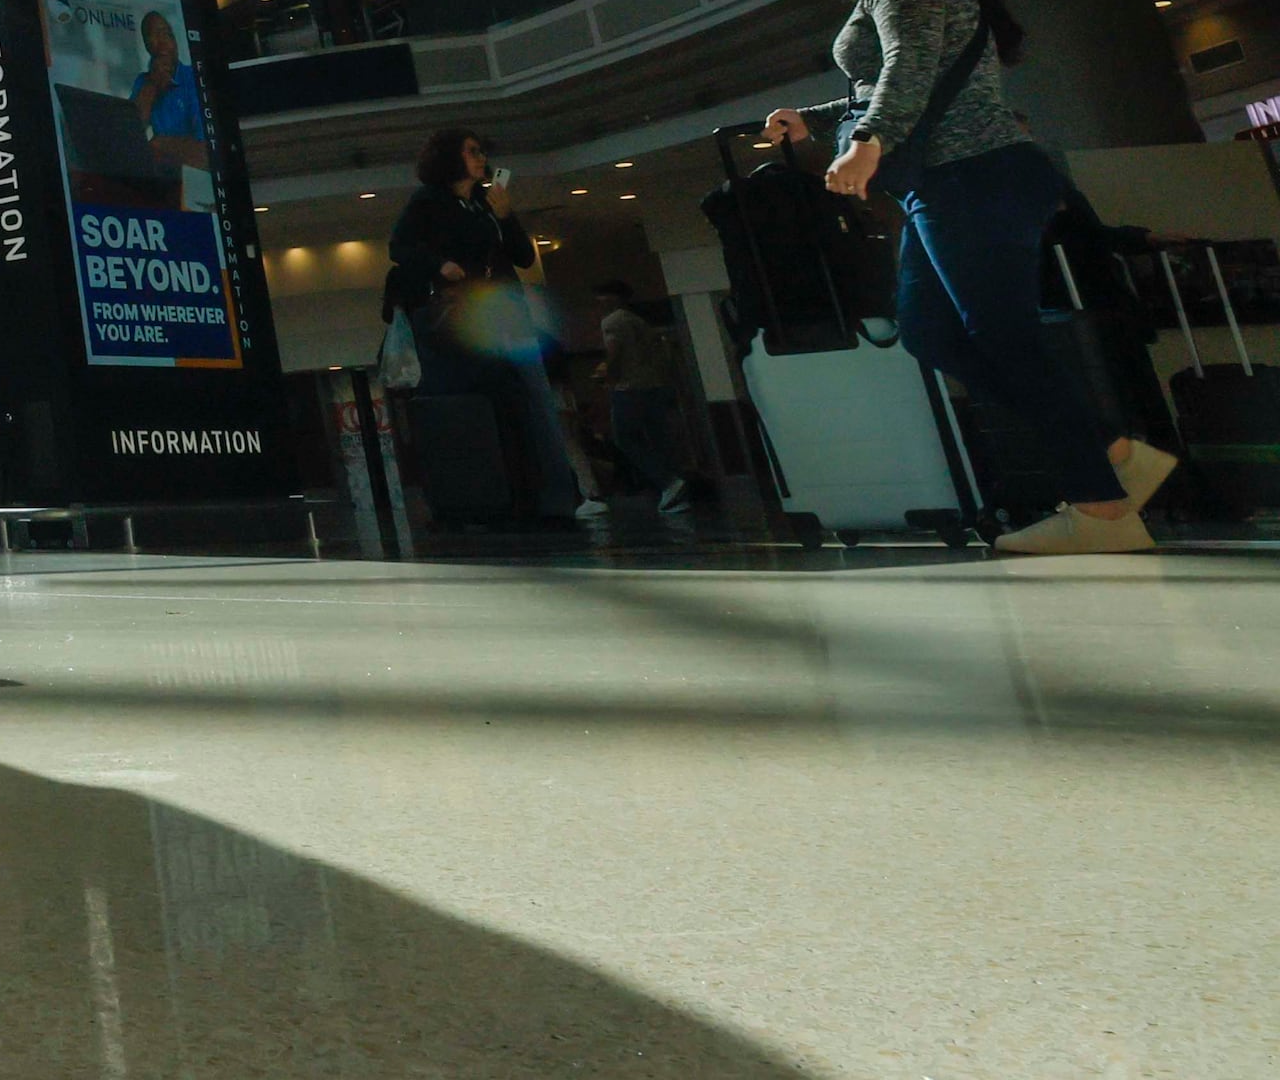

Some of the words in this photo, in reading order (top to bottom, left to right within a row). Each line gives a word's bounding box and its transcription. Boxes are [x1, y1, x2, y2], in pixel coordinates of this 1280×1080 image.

[74, 6, 136, 32] ONLINE
[196, 60, 217, 151] FLIGHT
[215, 170, 252, 350] INFORMATION
[80, 213, 169, 252] SOAR
[85, 255, 220, 295] BEYOND.
[92, 302, 139, 321] FROM
[140, 303, 226, 325] WHEREVER
[96, 323, 131, 342] YOU
[133, 324, 169, 344] ARE.
[111, 430, 262, 455] INFORMATION
